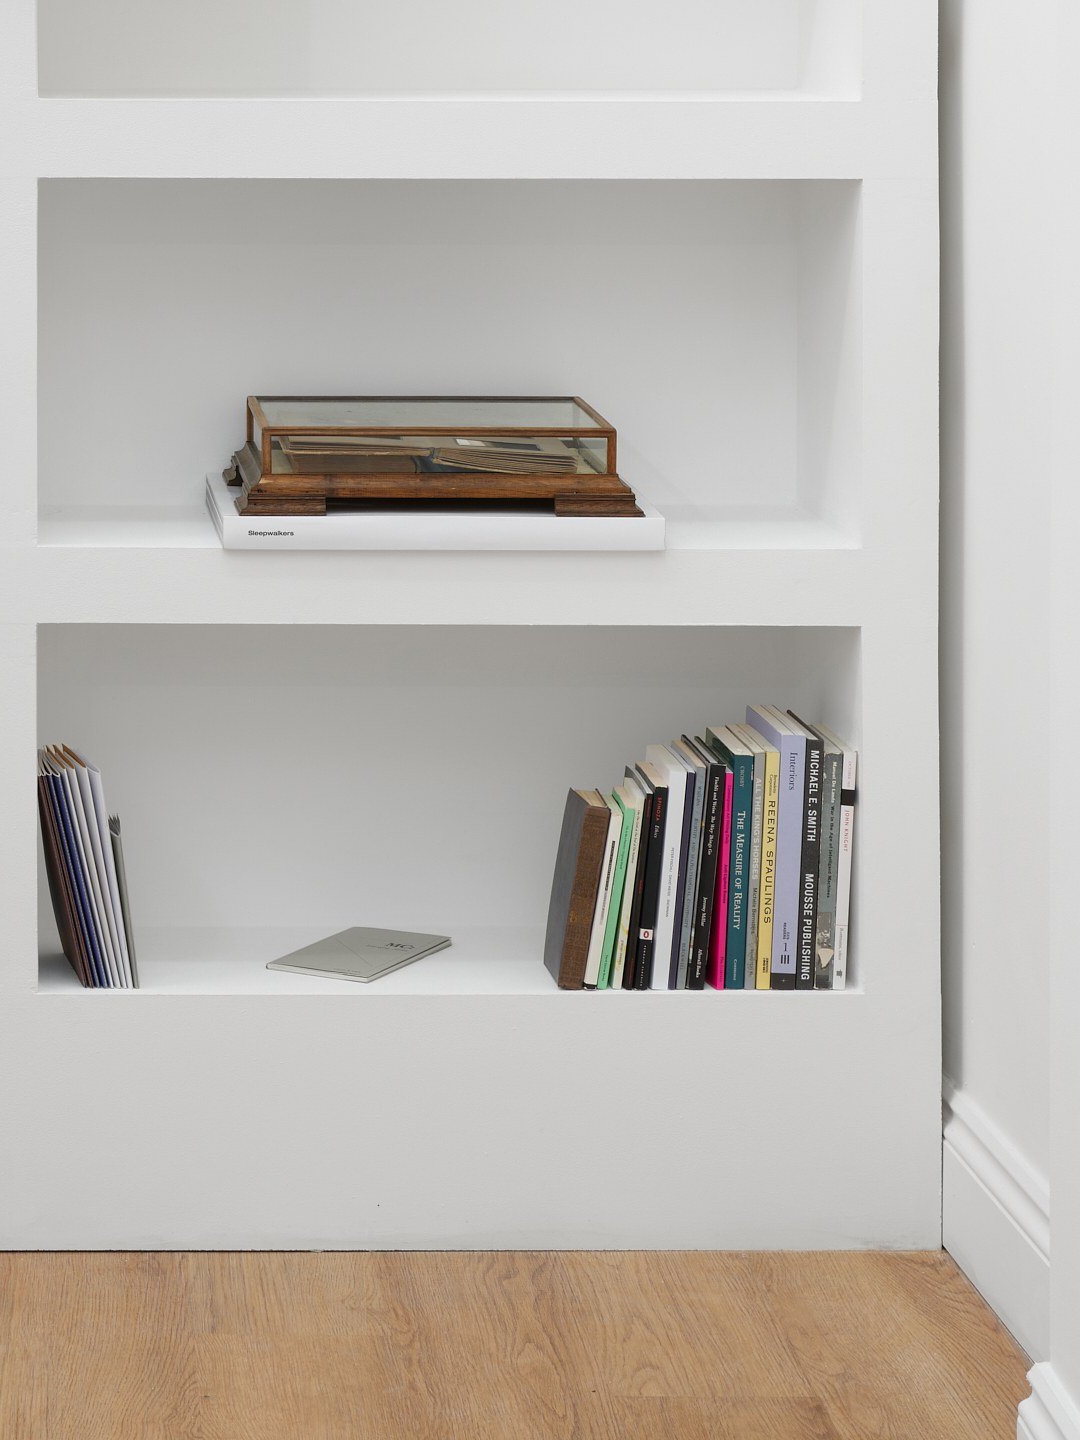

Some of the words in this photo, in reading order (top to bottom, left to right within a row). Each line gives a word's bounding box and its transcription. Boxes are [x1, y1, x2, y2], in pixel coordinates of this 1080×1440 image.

[247, 529, 295, 537] Sleepwalkers
[788, 752, 798, 790] Interiors
[809, 750, 820, 794] MICHAEL
[832, 780, 837, 788] De
[808, 797, 818, 806] E.
[737, 810, 746, 830] THE
[766, 800, 776, 844] REENA
[807, 810, 816, 842] SMITH
[708, 848, 713, 856] Go
[736, 833, 745, 876] MEASURE
[752, 845, 760, 880] HORSES
[734, 878, 742, 889] OF
[764, 850, 774, 924] SPAULINGS
[804, 874, 814, 916] MOUSSE
[700, 897, 708, 912] Jeremy
[733, 892, 743, 930] REALITY
[801, 918, 812, 980] PUBLISHING
